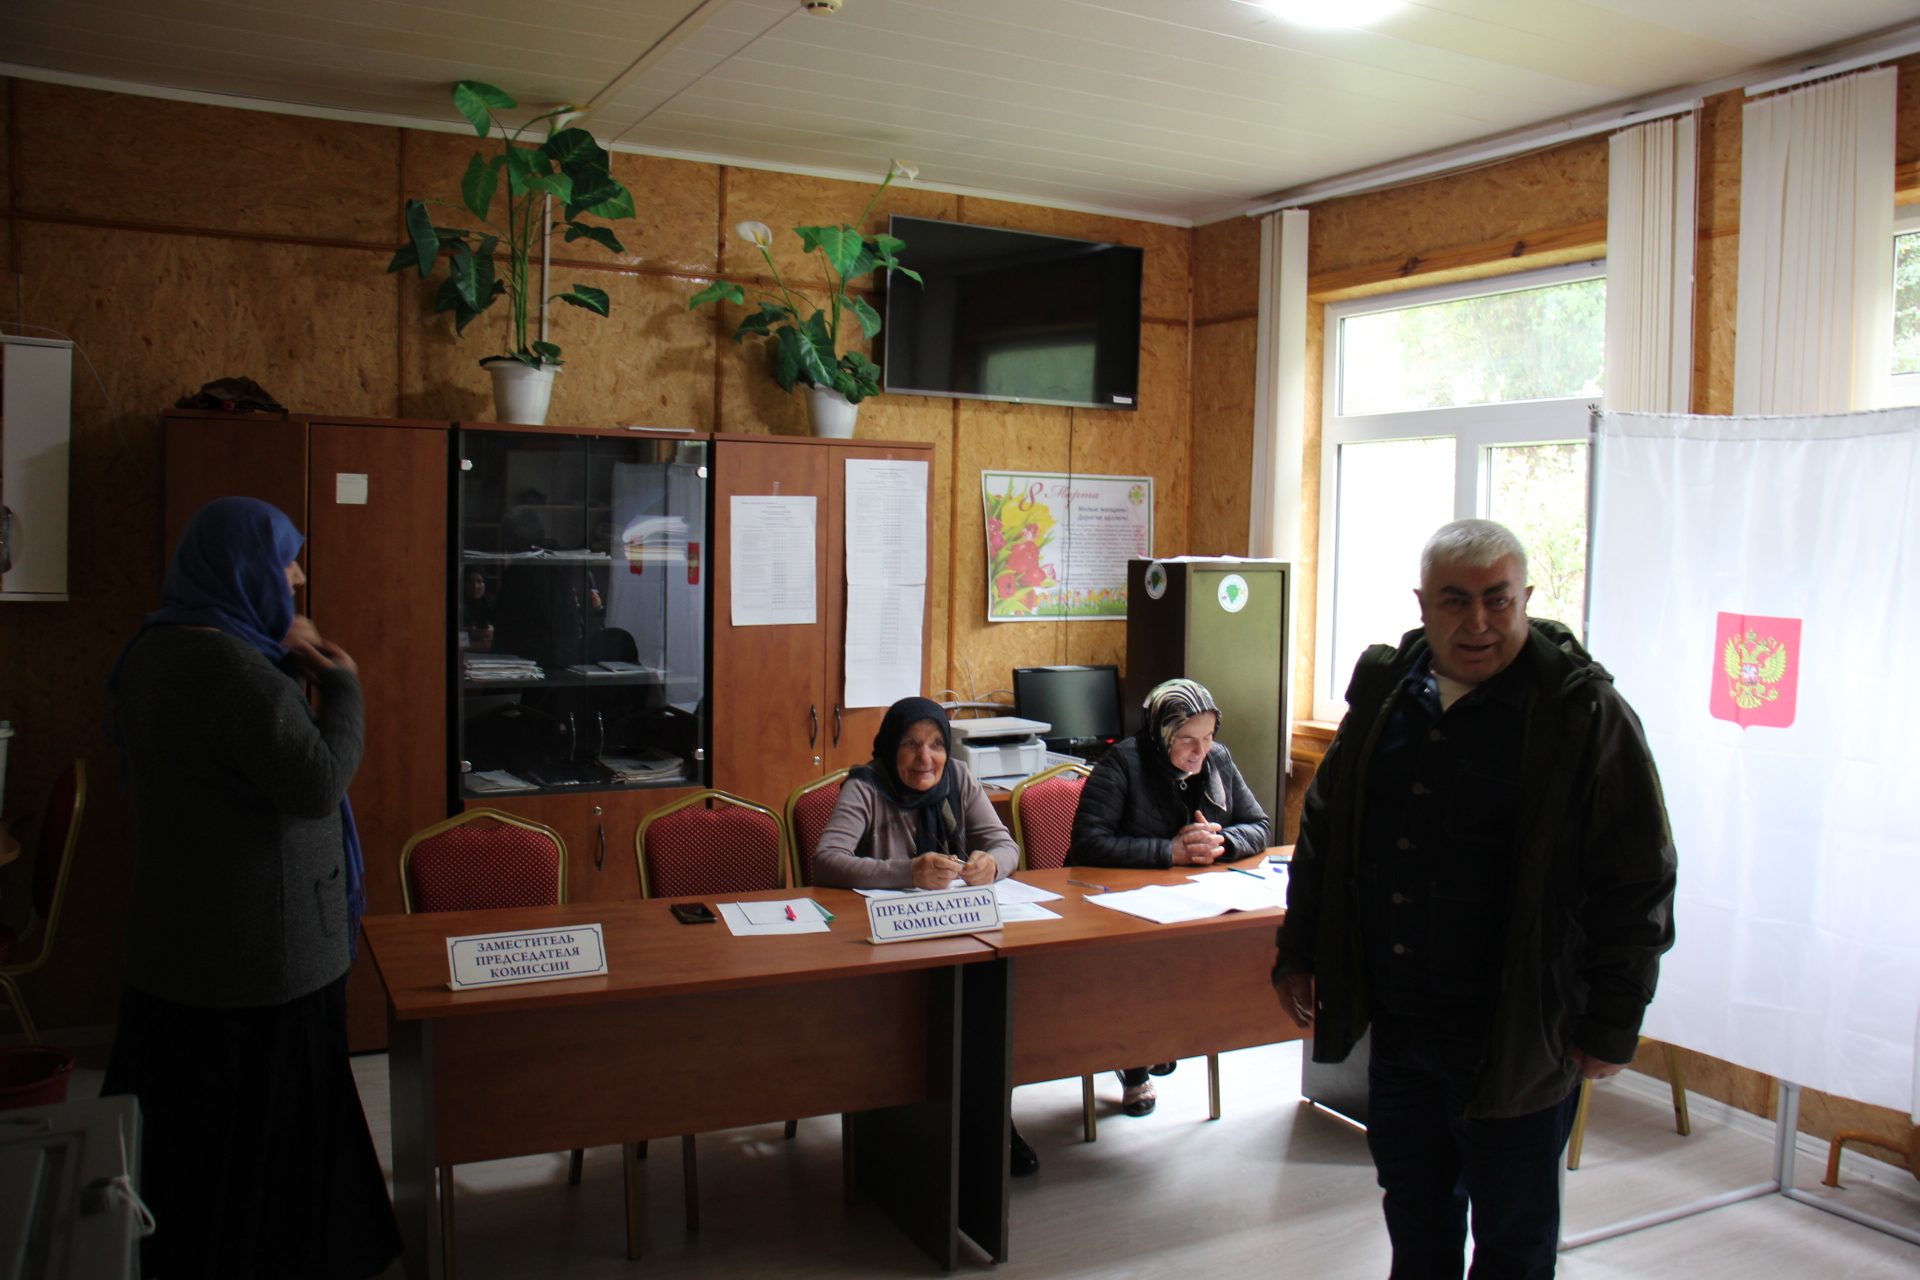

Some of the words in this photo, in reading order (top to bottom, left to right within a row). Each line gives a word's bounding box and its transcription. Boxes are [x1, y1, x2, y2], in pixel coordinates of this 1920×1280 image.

[1018, 482, 1043, 512] 8
[1044, 484, 1099, 509] Марта
[1076, 513, 1103, 521] Дорогие
[875, 895, 991, 917] ПРЕДСЕДАТЕЛЬ
[892, 911, 981, 931] КОМИССИИ
[477, 934, 575, 953] ЗАМЕСТИТЕЛЬ
[475, 946, 580, 966] ПРЕДСЕДАТЕЛЯ
[490, 961, 570, 978] КОМИССИИ
